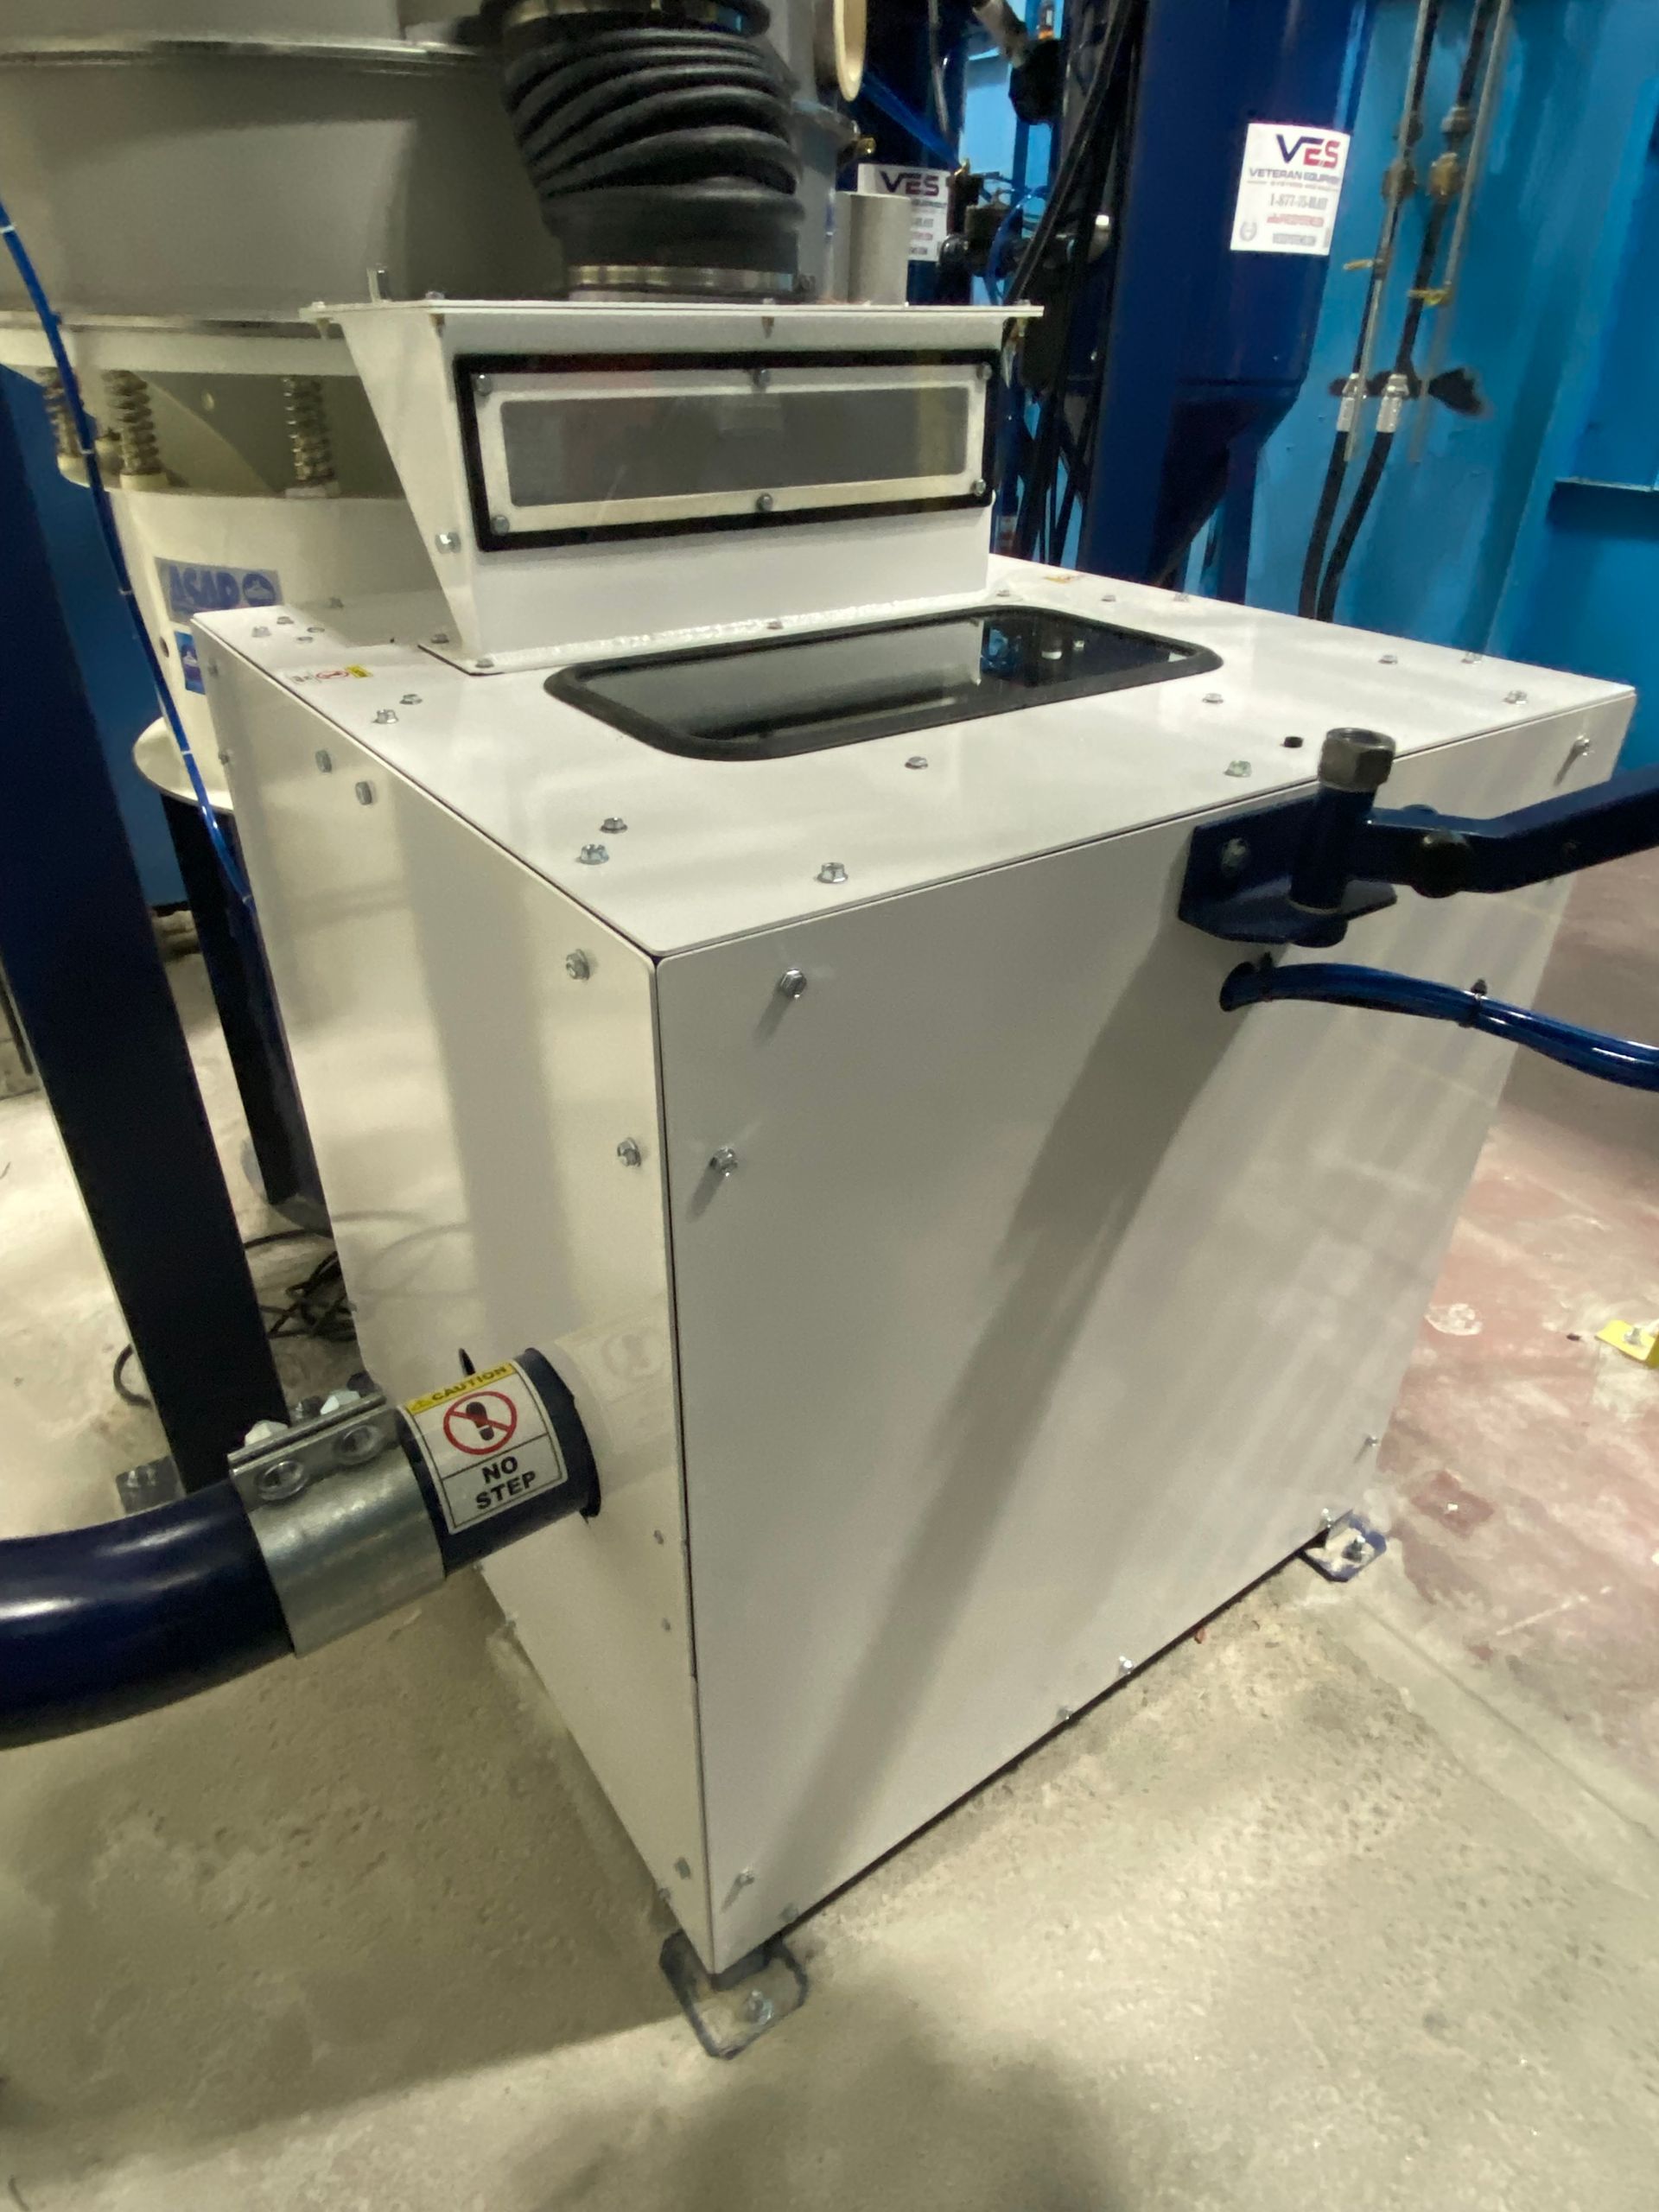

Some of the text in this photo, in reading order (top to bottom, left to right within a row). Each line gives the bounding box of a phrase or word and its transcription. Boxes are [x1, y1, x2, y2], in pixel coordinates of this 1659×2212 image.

[1276, 134, 1341, 168] VES
[879, 171, 939, 196] VES
[1249, 168, 1302, 180] VETERAN
[432, 1365, 507, 1401] CAUTION
[481, 1456, 518, 1484] NO
[476, 1471, 537, 1510] STEP
